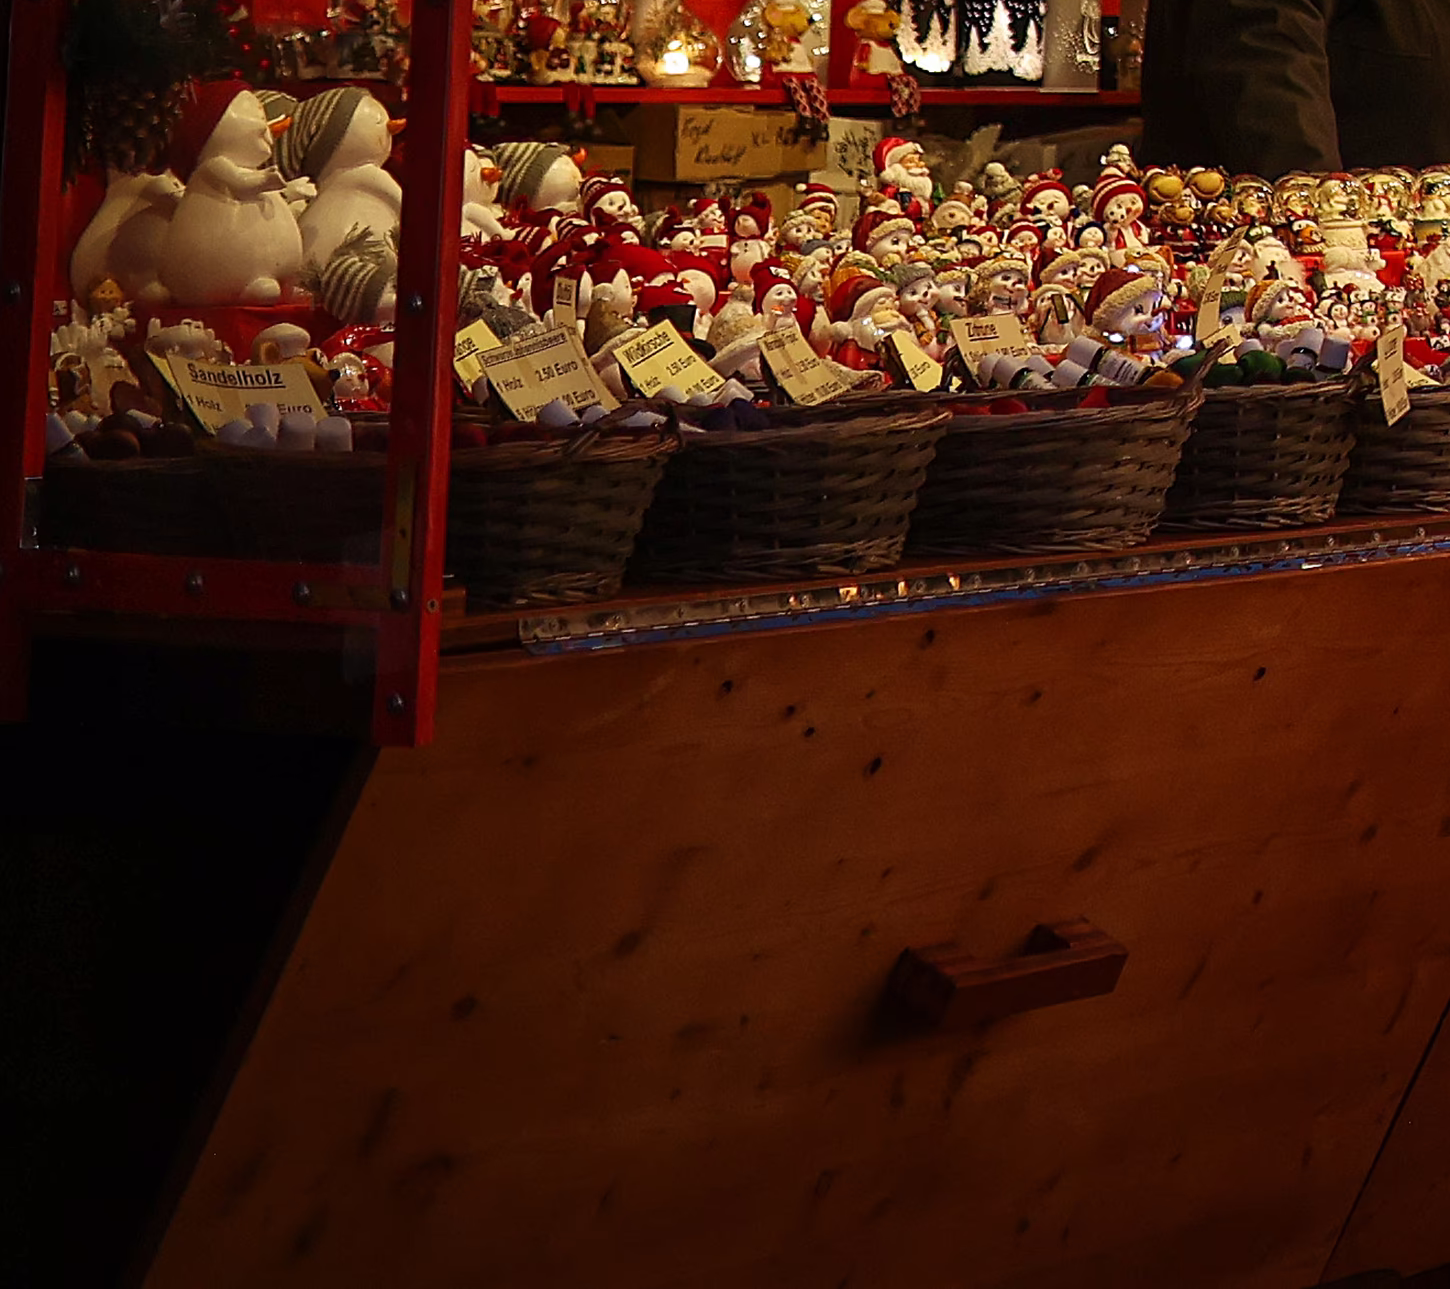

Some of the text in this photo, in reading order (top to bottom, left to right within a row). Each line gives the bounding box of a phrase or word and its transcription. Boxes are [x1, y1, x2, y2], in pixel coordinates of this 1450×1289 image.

[187, 363, 284, 387] Sandelholz
[503, 376, 524, 392] Holz
[553, 360, 578, 377] Euro
[197, 395, 222, 412] Holz
[277, 402, 313, 416] Euro
[572, 388, 596, 406] Euro
